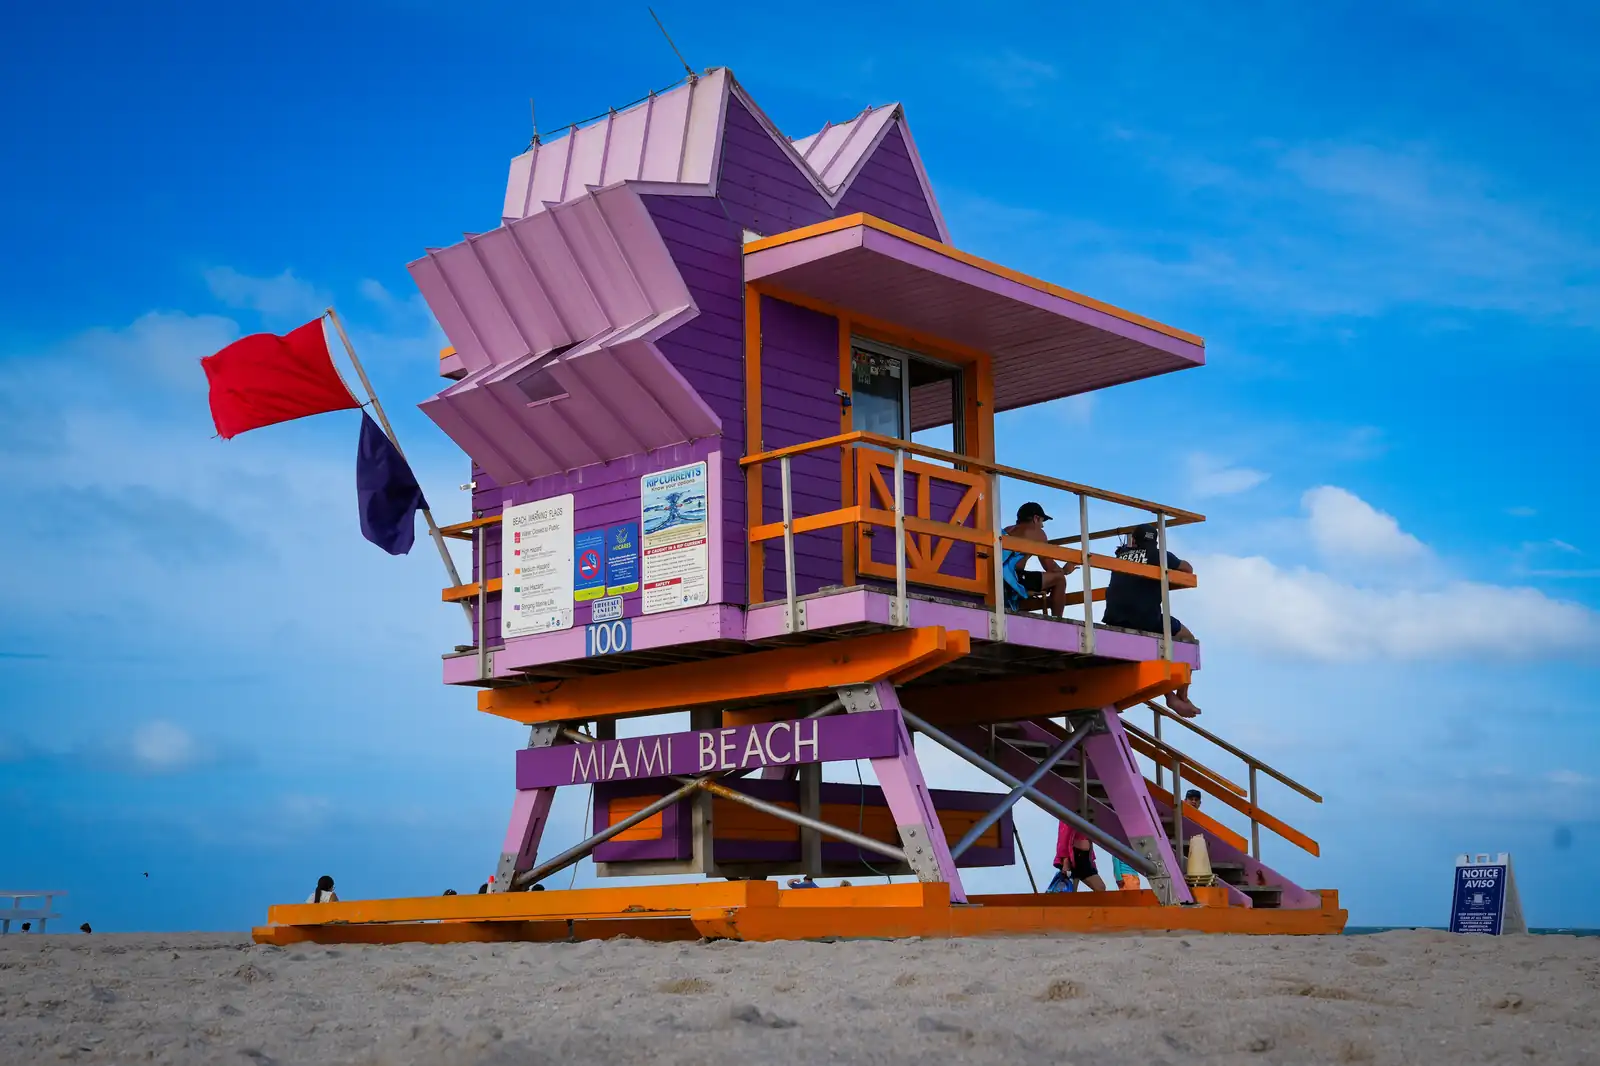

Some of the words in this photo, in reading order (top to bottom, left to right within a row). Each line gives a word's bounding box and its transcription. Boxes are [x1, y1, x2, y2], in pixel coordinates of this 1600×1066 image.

[646, 477, 658, 488] RIP
[659, 467, 702, 485] CURRENTS
[666, 482, 677, 490] your
[512, 515, 527, 526] BEACH
[528, 509, 548, 522] WARNING
[549, 507, 563, 518] FLAGS
[651, 545, 668, 554] CAUGHT
[589, 621, 627, 656] 100
[571, 737, 672, 783] MIAMI
[699, 719, 818, 771] BEACH
[1462, 869, 1498, 878] NOTICE
[1464, 880, 1495, 888] AVISO
